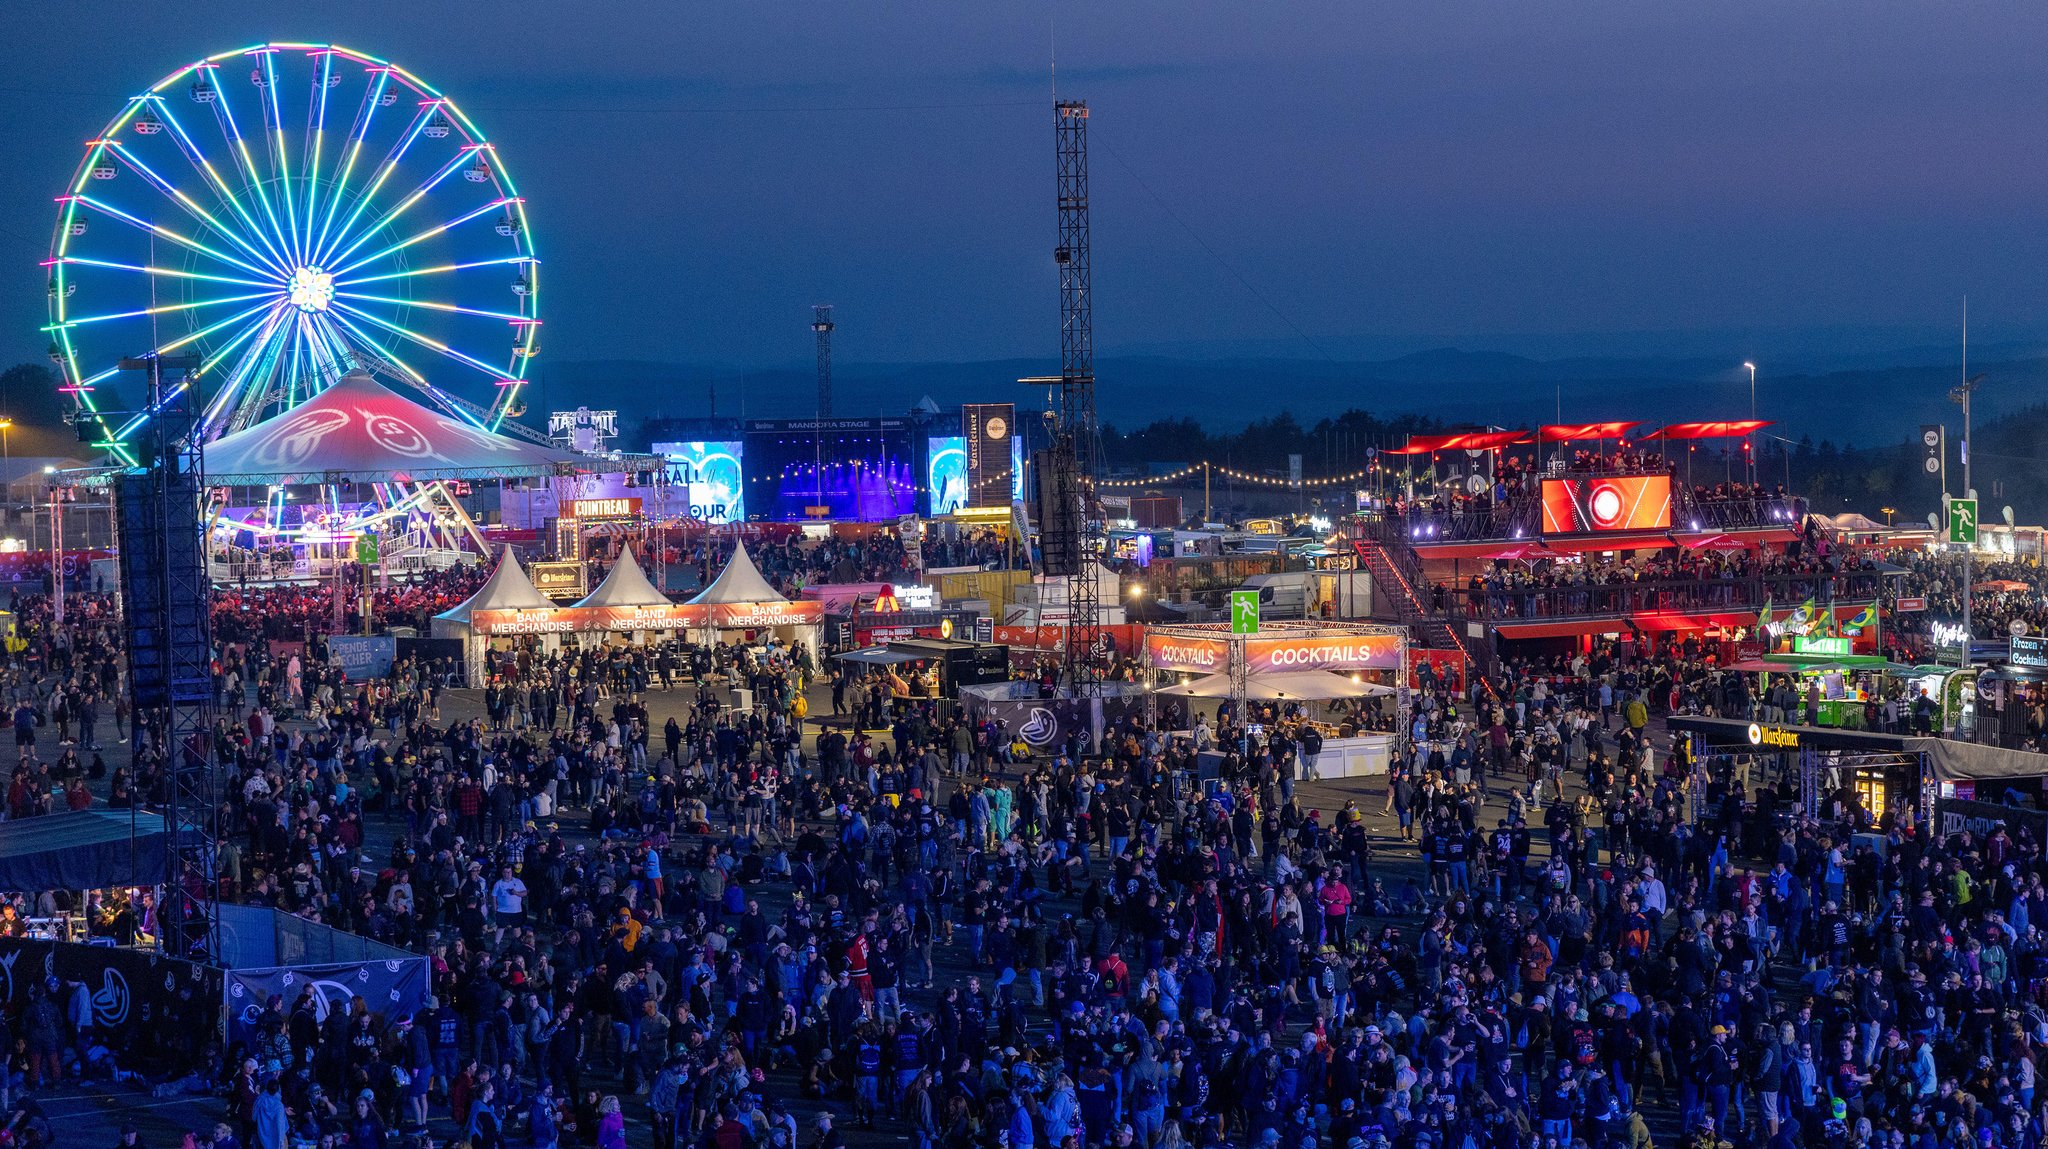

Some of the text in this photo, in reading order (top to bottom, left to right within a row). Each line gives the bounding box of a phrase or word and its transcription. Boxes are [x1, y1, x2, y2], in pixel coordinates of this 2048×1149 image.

[788, 420, 870, 429] MANDORA STAGE
[970, 413, 978, 470] Warsteiner
[575, 499, 630, 516] COINTREAU
[550, 573, 576, 583] Warsteiner
[517, 613, 549, 622] BAND
[635, 609, 666, 619] BAND
[752, 605, 783, 616] BAND
[491, 621, 574, 633] MERCHANDISE
[610, 617, 691, 630] MERCHANDISE
[728, 614, 806, 626] MERCHANDISE
[2012, 636, 2038, 650] Frozen
[1161, 644, 1215, 666] COCKTAILS
[1271, 645, 1371, 666] COCKTAILS
[2012, 652, 2048, 667] Cocktails
[1761, 726, 1799, 749] Warsteiner
[1942, 811, 1967, 837] ROCK
[1497, 837, 1512, 853] 24
